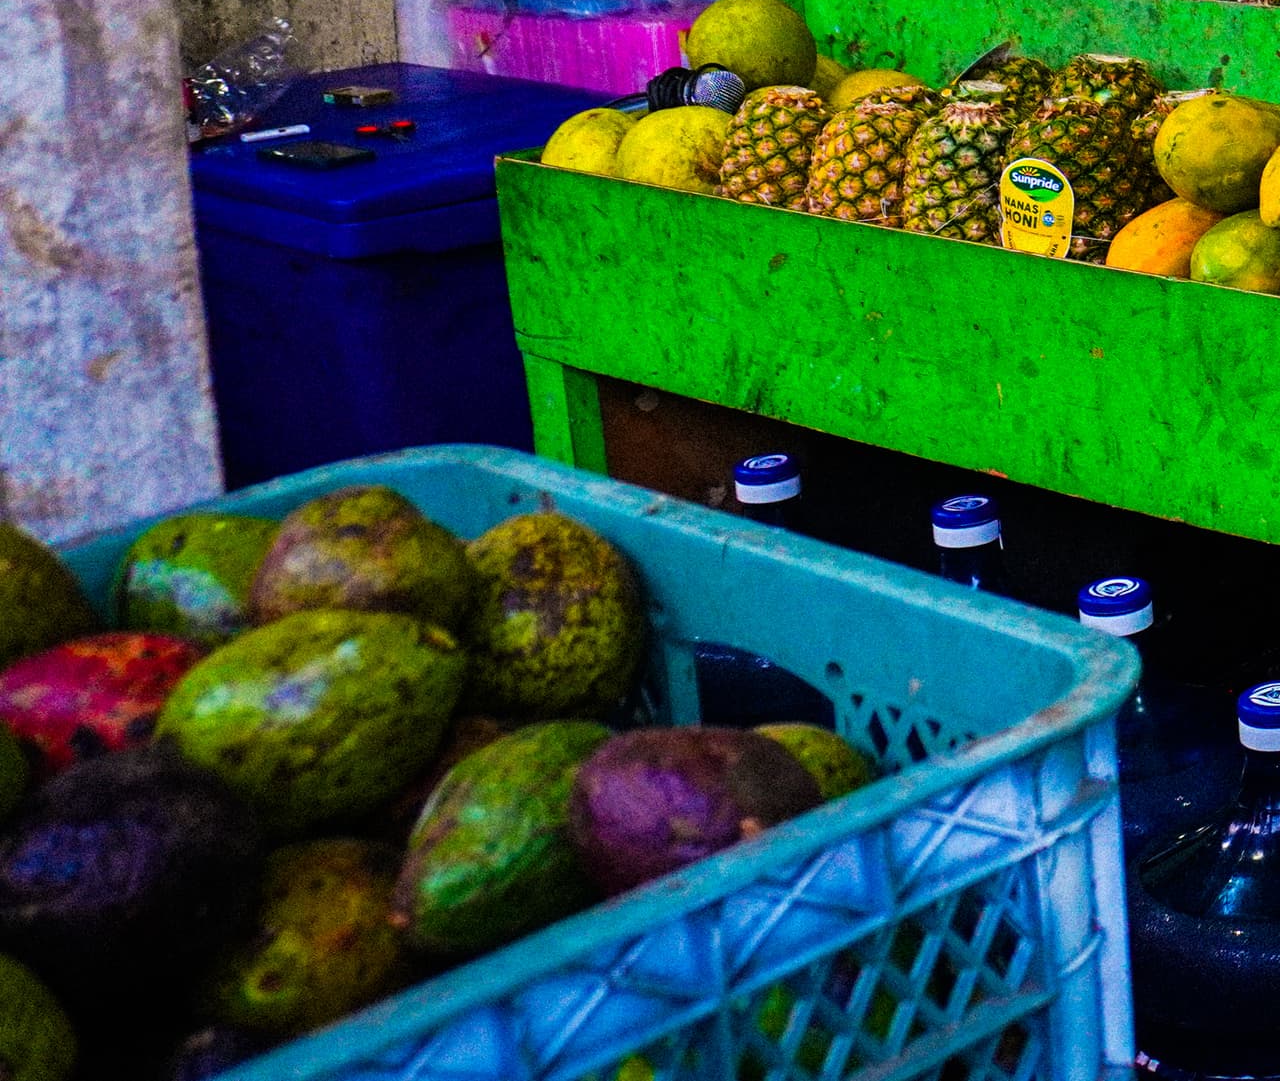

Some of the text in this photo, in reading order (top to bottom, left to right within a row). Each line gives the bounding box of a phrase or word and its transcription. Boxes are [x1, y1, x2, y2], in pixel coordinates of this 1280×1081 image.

[1011, 171, 1060, 191] Sunpride
[1004, 196, 1038, 214] NANAS
[1006, 207, 1037, 228] HONI
